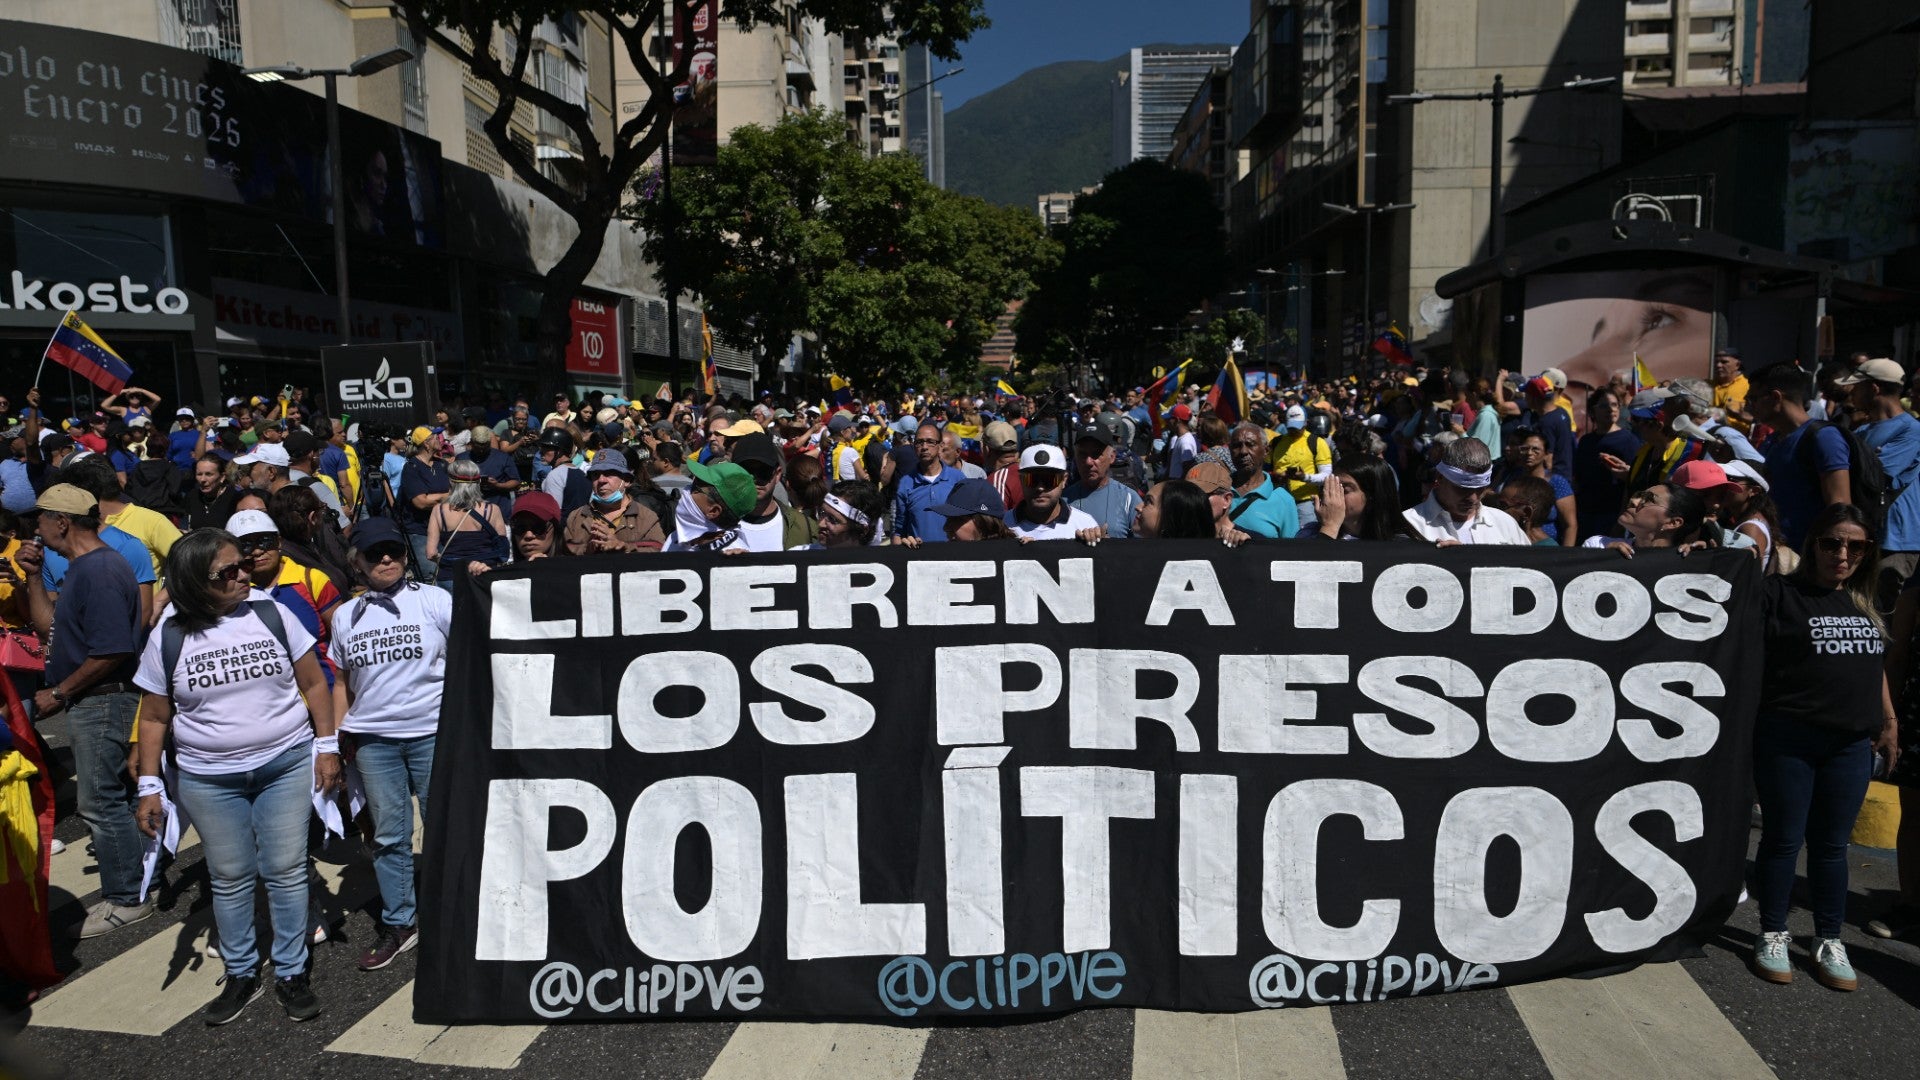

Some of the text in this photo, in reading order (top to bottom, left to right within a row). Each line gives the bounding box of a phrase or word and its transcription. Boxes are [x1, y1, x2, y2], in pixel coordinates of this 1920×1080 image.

[77, 61, 122, 91] en
[141, 68, 226, 111] cines
[24, 84, 142, 128] Enero
[74, 142, 116, 154] IMAX
[145, 150, 170, 162] Dolby
[0, 270, 189, 315] kosto
[214, 294, 381, 339] Kitchenid
[581, 331, 604, 359] 100
[339, 377, 413, 401] EKO
[343, 400, 413, 410] ILUMINACIÓN
[490, 557, 1733, 642] LIBEREN A TODOS
[347, 624, 421, 644] LIBEREN A TODOS
[1808, 616, 1870, 627] CIERREN
[1810, 627, 1880, 639] CENTROS
[184, 639, 275, 665] LIBEREN A TODOS
[347, 633, 421, 656] LOS PRESOS
[187, 649, 278, 675] LOS PRESOS
[348, 646, 424, 671] POLÍTICOS
[188, 661, 283, 692] POLÍTICOS
[490, 642, 1726, 763] LOS PRESOS
[474, 745, 1705, 965] POLÍTICOS
